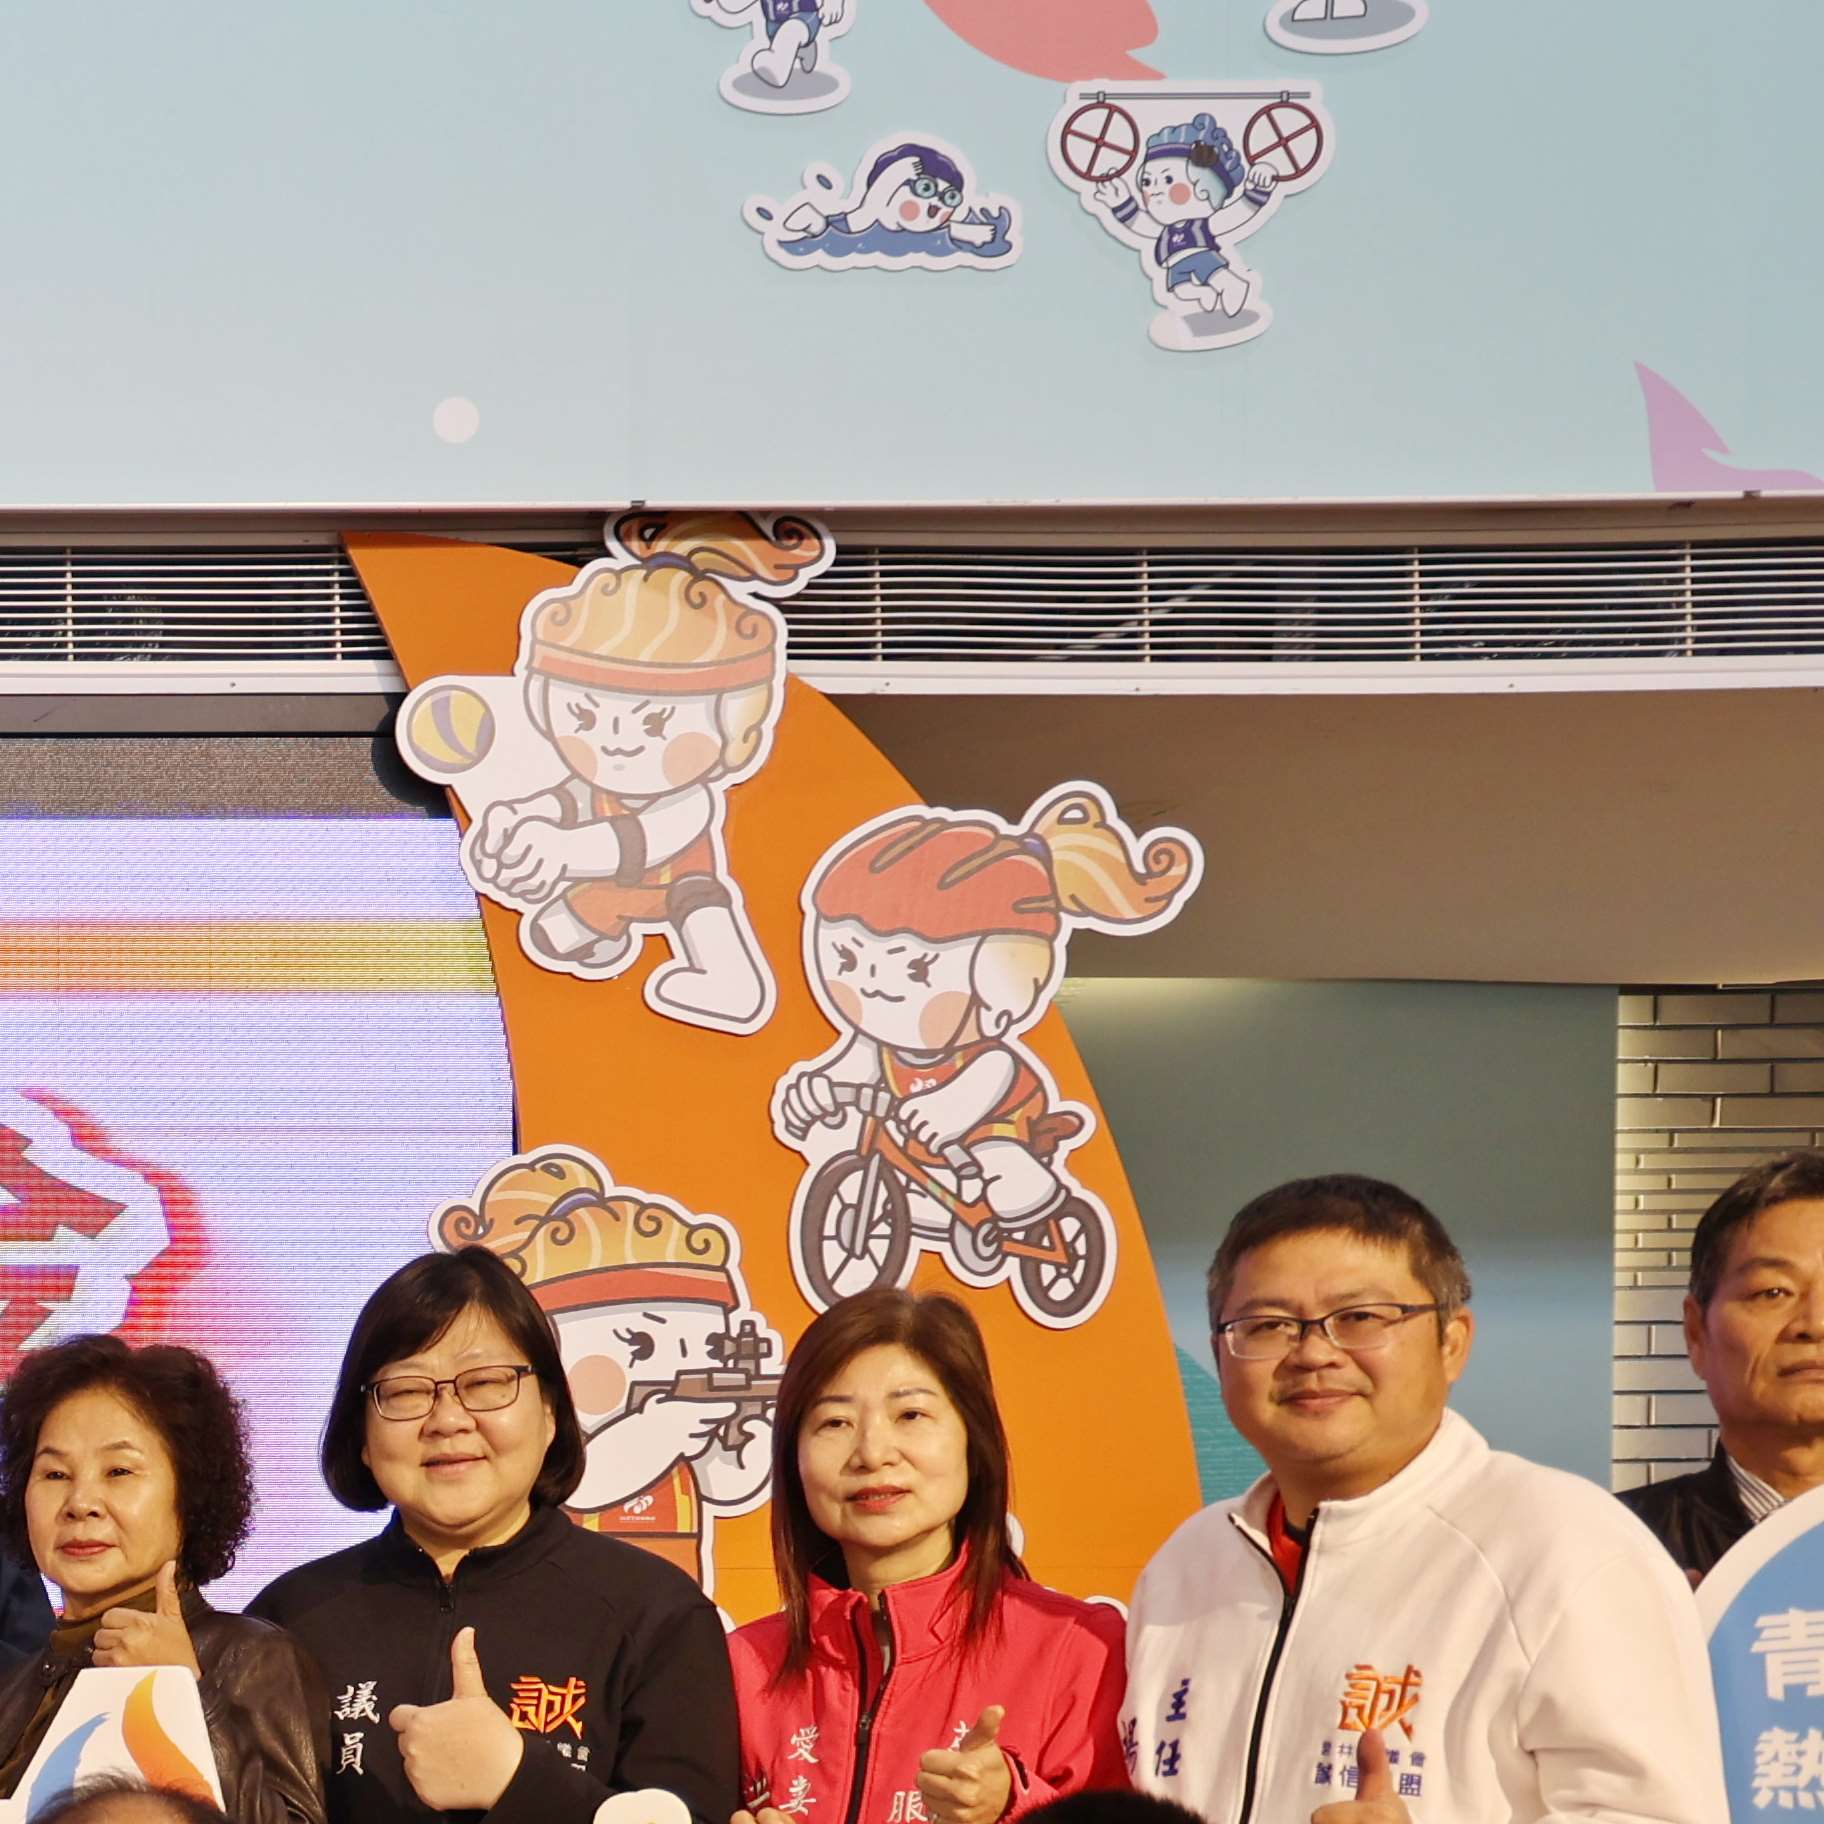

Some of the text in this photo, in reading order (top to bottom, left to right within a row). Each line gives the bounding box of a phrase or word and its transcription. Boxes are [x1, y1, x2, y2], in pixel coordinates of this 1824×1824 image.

[333, 1680, 380, 1775] 議員
[1154, 1678, 1191, 1777] 主任
[1314, 1763, 1423, 1797] 誠信盟
